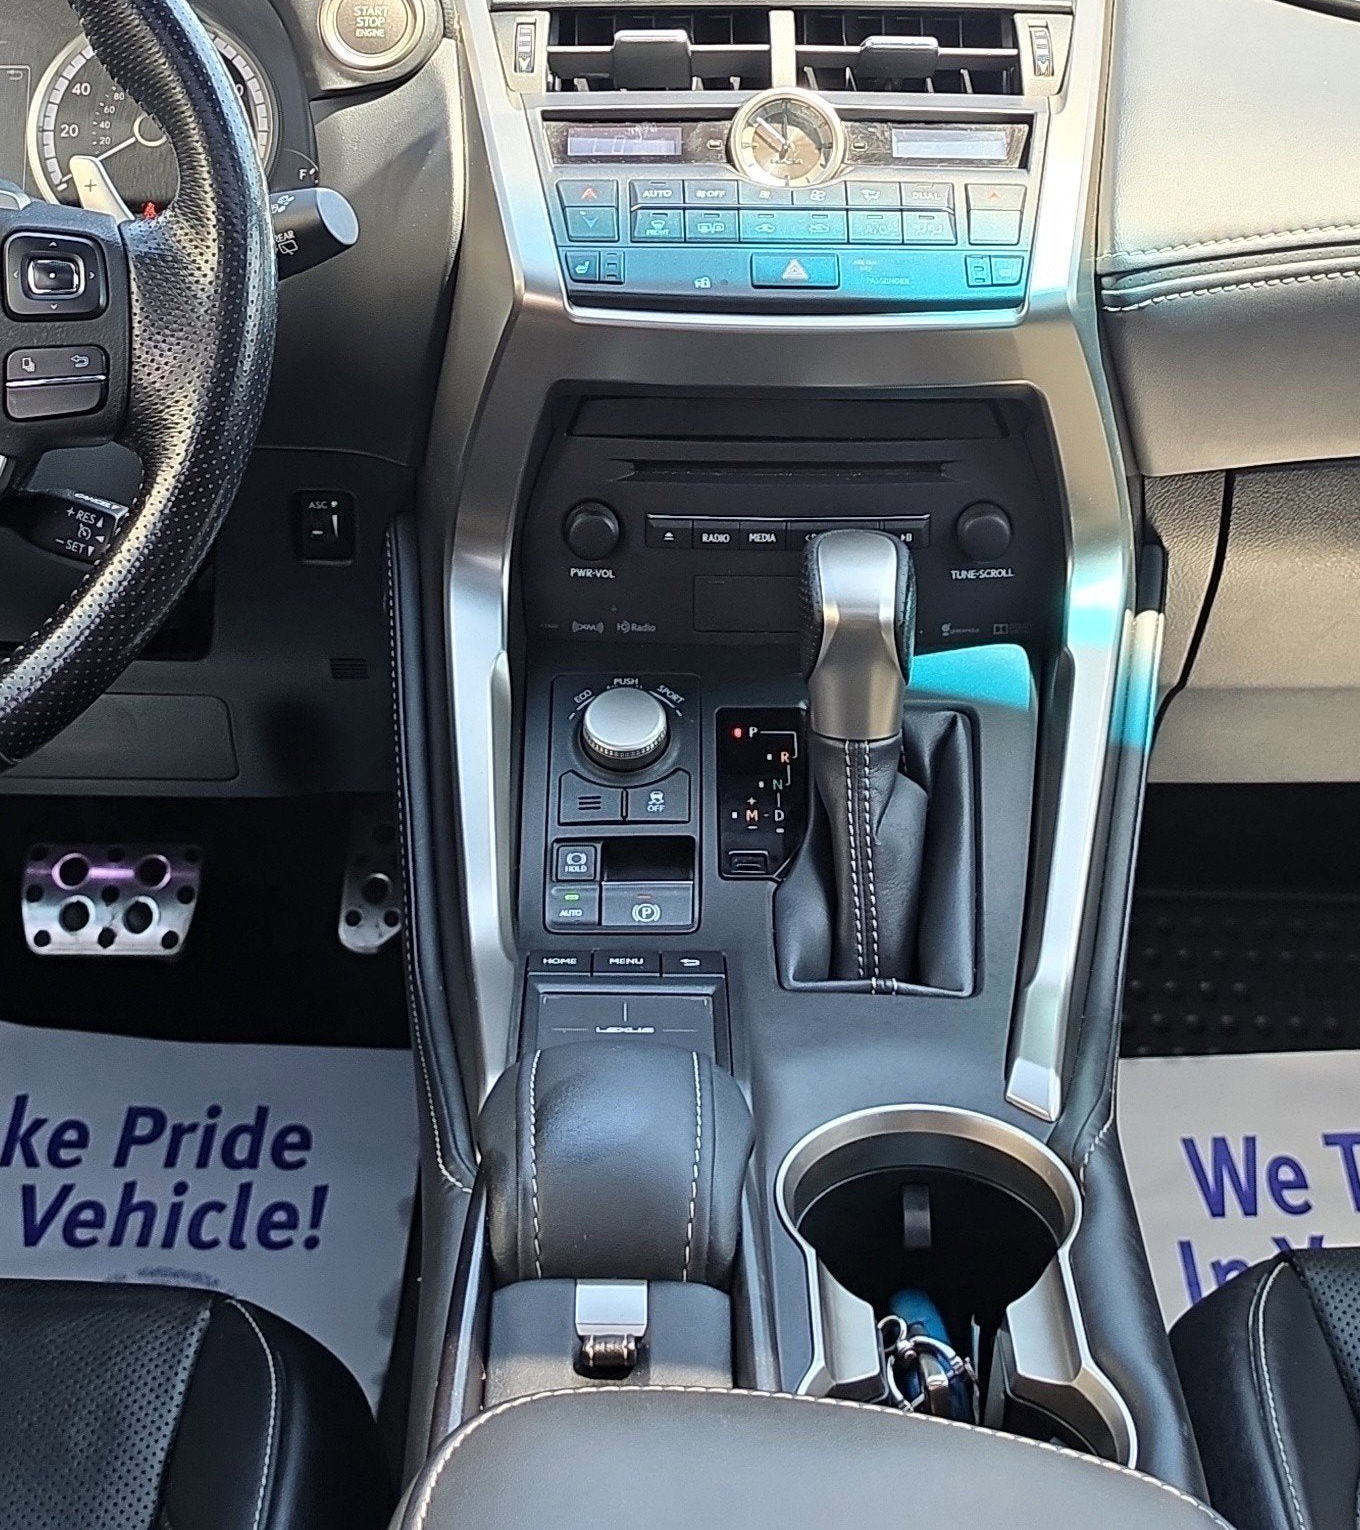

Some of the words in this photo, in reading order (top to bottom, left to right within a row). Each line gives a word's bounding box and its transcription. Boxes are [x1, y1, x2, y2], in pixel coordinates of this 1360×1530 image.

[353, 5, 389, 17] START
[356, 17, 386, 28] STOP
[355, 28, 385, 38] ENGINE
[71, 82, 91, 97] 40
[113, 91, 125, 101] 80
[103, 105, 115, 114] 60
[99, 120, 111, 129] 40
[60, 124, 79, 138] 20
[99, 136, 111, 146] 20
[299, 169, 308, 181] F
[642, 189, 672, 199] AUTO
[707, 189, 726, 199] OFF
[912, 191, 941, 201] DUAL
[308, 500, 328, 510] ASC
[75, 510, 97, 525] RES
[701, 533, 731, 544] RADIO
[748, 532, 777, 543] MEDIA
[65, 539, 87, 554] SET
[570, 567, 616, 579] PWR-VOL
[950, 568, 1015, 580] TUNE-SCROLL
[631, 622, 657, 633] Radio
[613, 677, 639, 687] PUSH
[573, 689, 593, 704] ECO
[657, 684, 685, 704] SPORT
[748, 726, 759, 739] P
[780, 751, 790, 764] R
[772, 779, 783, 790] N
[647, 804, 666, 813] OFF
[745, 809, 759, 822] M
[774, 809, 785, 822] D
[564, 865, 588, 873] HOLD
[559, 909, 583, 917] AUTO
[542, 957, 577, 965] HOME
[608, 957, 644, 965] MENU
[595, 1026, 655, 1034] LEXUS
[112, 1104, 313, 1171] Pride
[1181, 1134, 1312, 1220] We
[19, 1181, 330, 1252] Vehicle!
